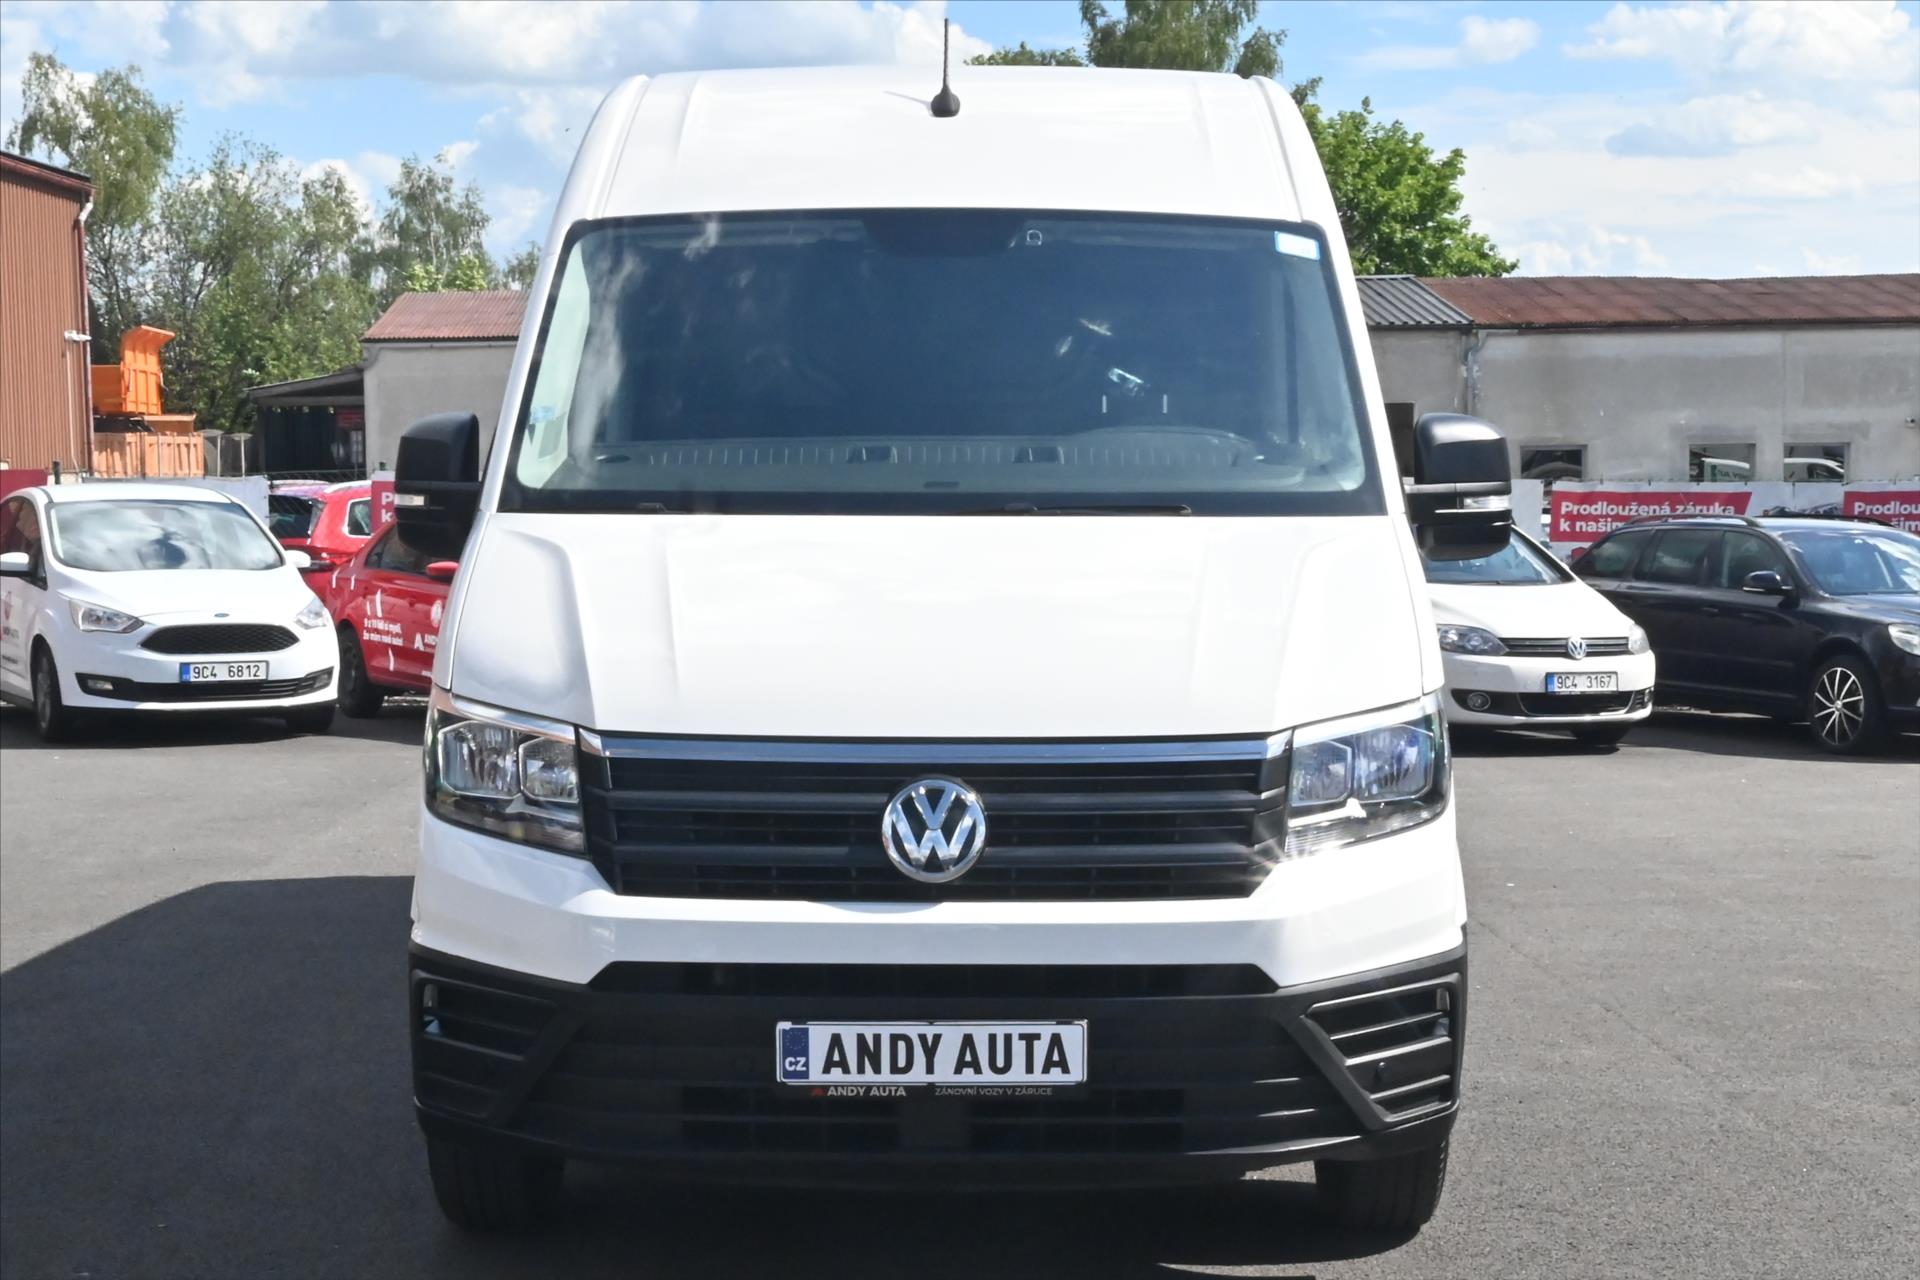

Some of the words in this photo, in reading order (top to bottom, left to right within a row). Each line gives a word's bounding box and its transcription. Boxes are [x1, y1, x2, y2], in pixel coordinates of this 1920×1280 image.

[1561, 501, 1671, 516] Prodloužená
[1675, 501, 1735, 516] záruka
[1560, 518, 1571, 532] k
[193, 666, 217, 679] 9C4
[228, 665, 260, 678] 6812
[1557, 675, 1577, 689] 9C4
[1586, 675, 1612, 688] 3167
[821, 1033, 943, 1075] ANDY
[953, 1033, 1071, 1075] AUTA
[784, 1057, 807, 1071] CZ
[827, 1086, 866, 1096] ANDY
[869, 1086, 906, 1096] AUTA
[935, 1086, 977, 1096] ZÁNOVNÍ
[979, 1087, 1004, 1096] VOZY
[1006, 1087, 1013, 1096] V
[1015, 1086, 1053, 1096] ZÁRUCE
